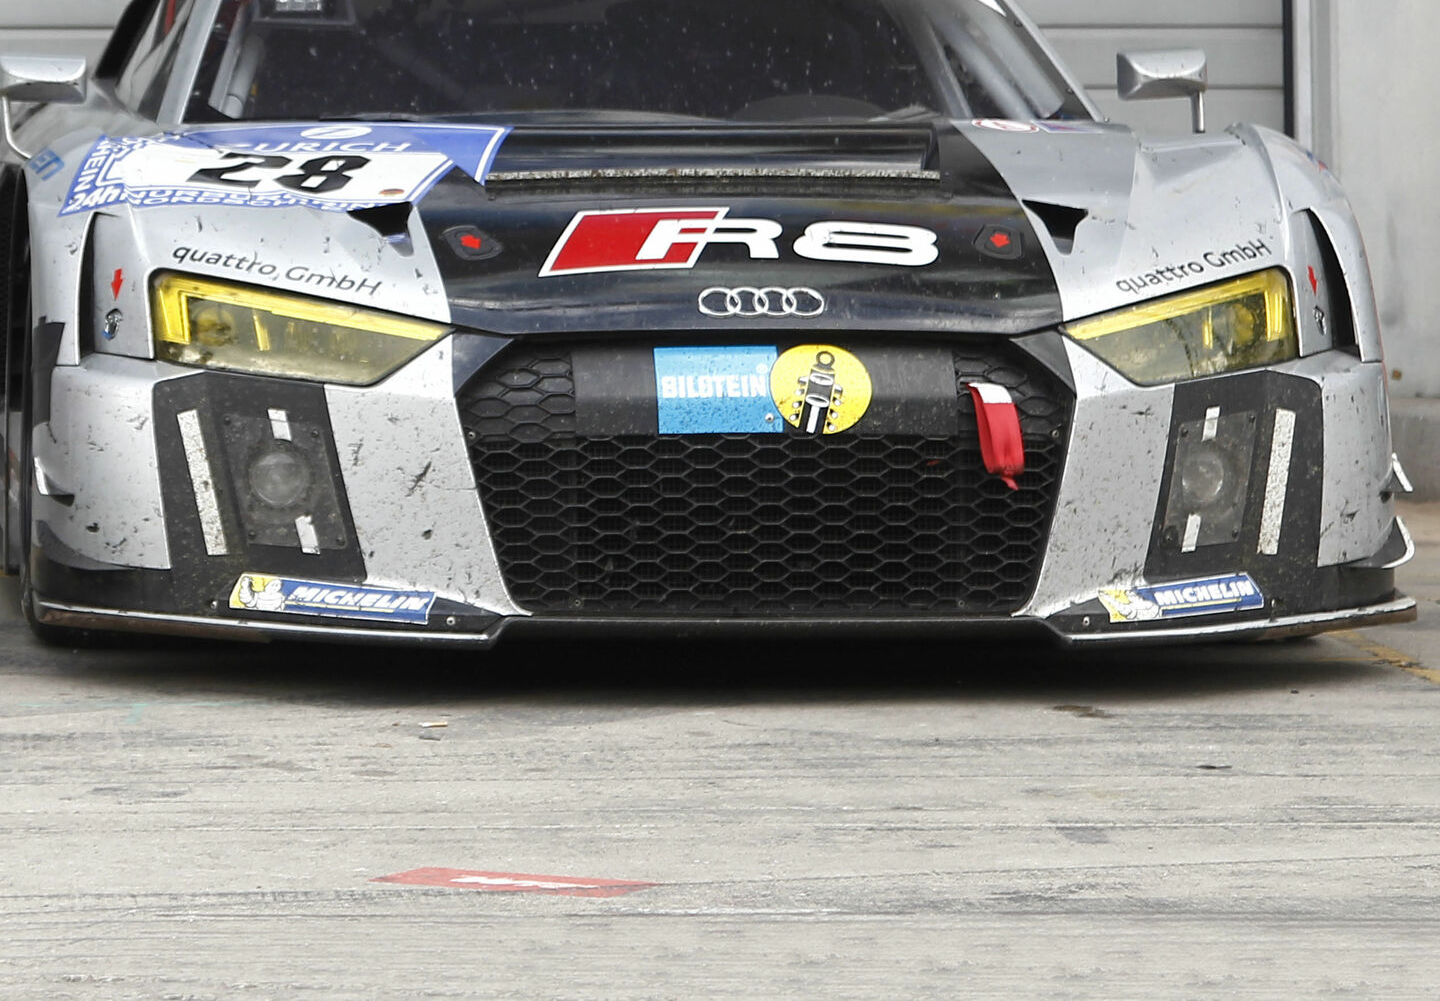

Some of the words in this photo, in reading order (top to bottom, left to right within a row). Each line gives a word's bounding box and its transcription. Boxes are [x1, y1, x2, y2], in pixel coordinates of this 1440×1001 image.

[186, 152, 371, 194] 28
[635, 217, 939, 266] R8
[171, 246, 276, 275] quattro
[285, 266, 382, 296] GmbH
[1115, 261, 1205, 295] quattro
[1203, 238, 1273, 268] GmbH
[661, 375, 767, 398] BILSTEIN
[288, 586, 428, 611] MICHELIN
[1154, 580, 1255, 606] MICHELIN
